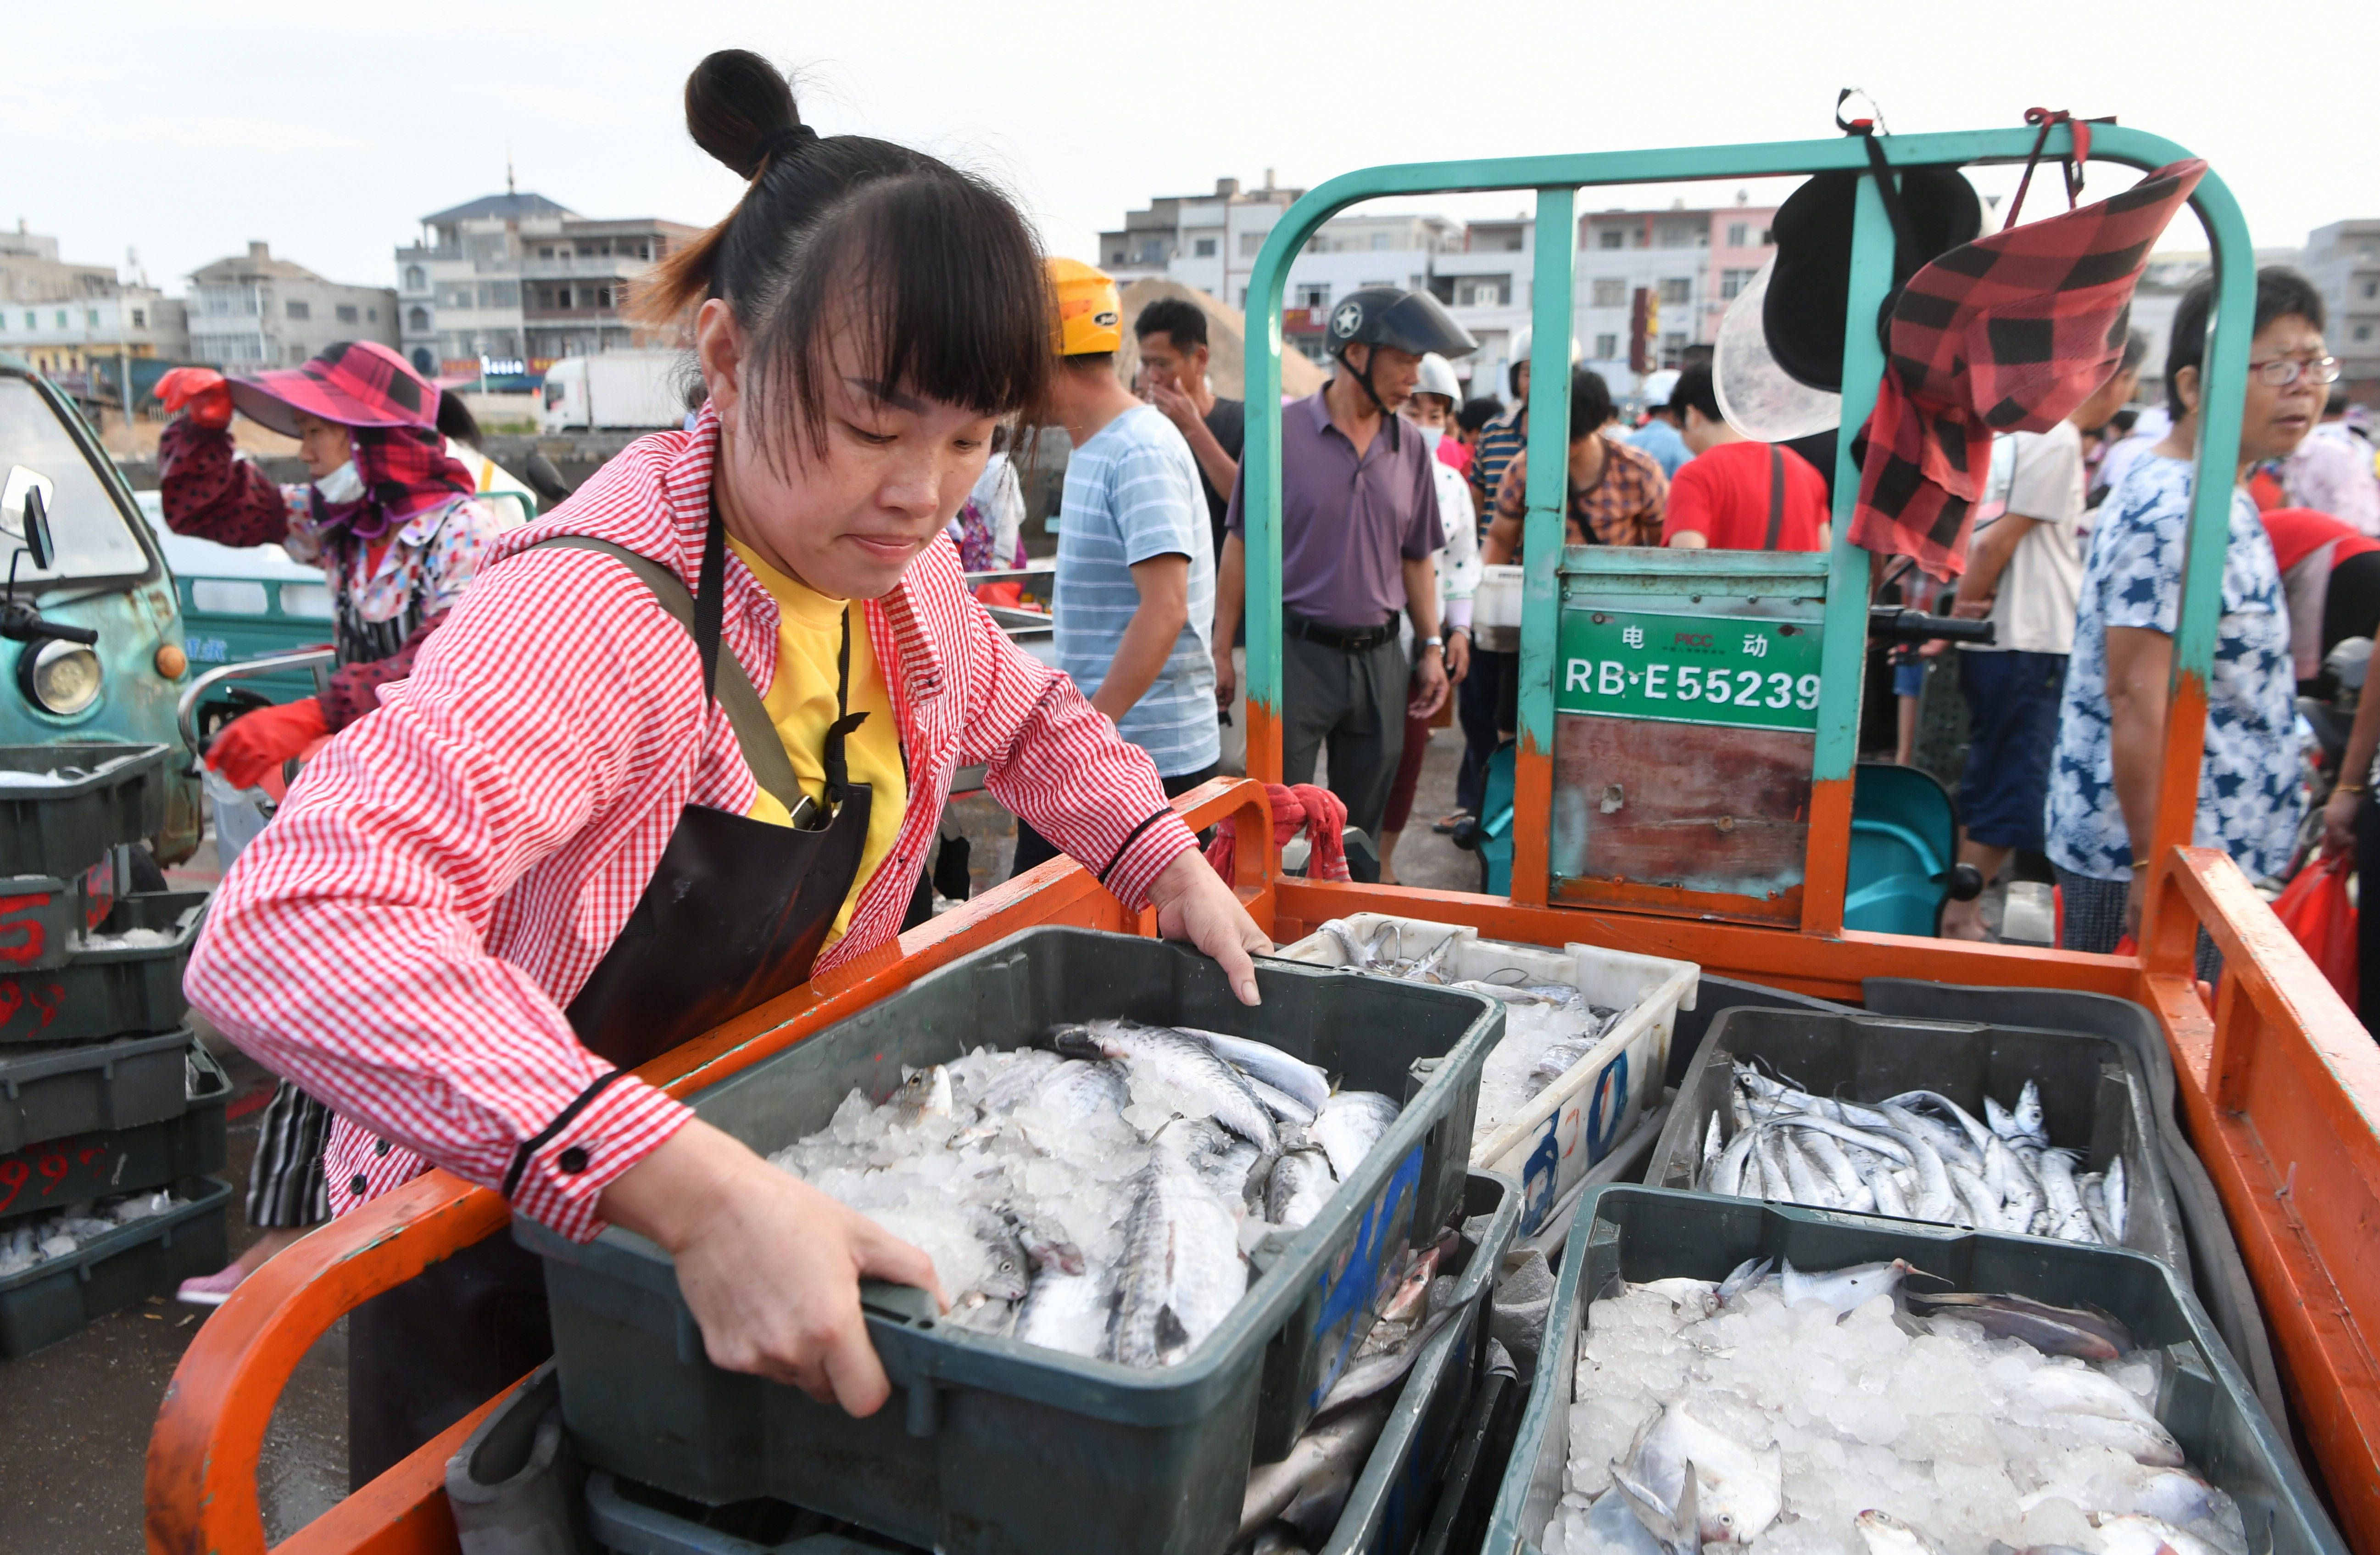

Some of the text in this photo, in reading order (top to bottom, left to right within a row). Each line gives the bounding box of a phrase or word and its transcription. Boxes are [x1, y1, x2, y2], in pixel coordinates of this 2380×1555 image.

[1622, 625, 1644, 649] 电
[1742, 633, 1768, 657] 动
[1675, 632, 1714, 647] PICC
